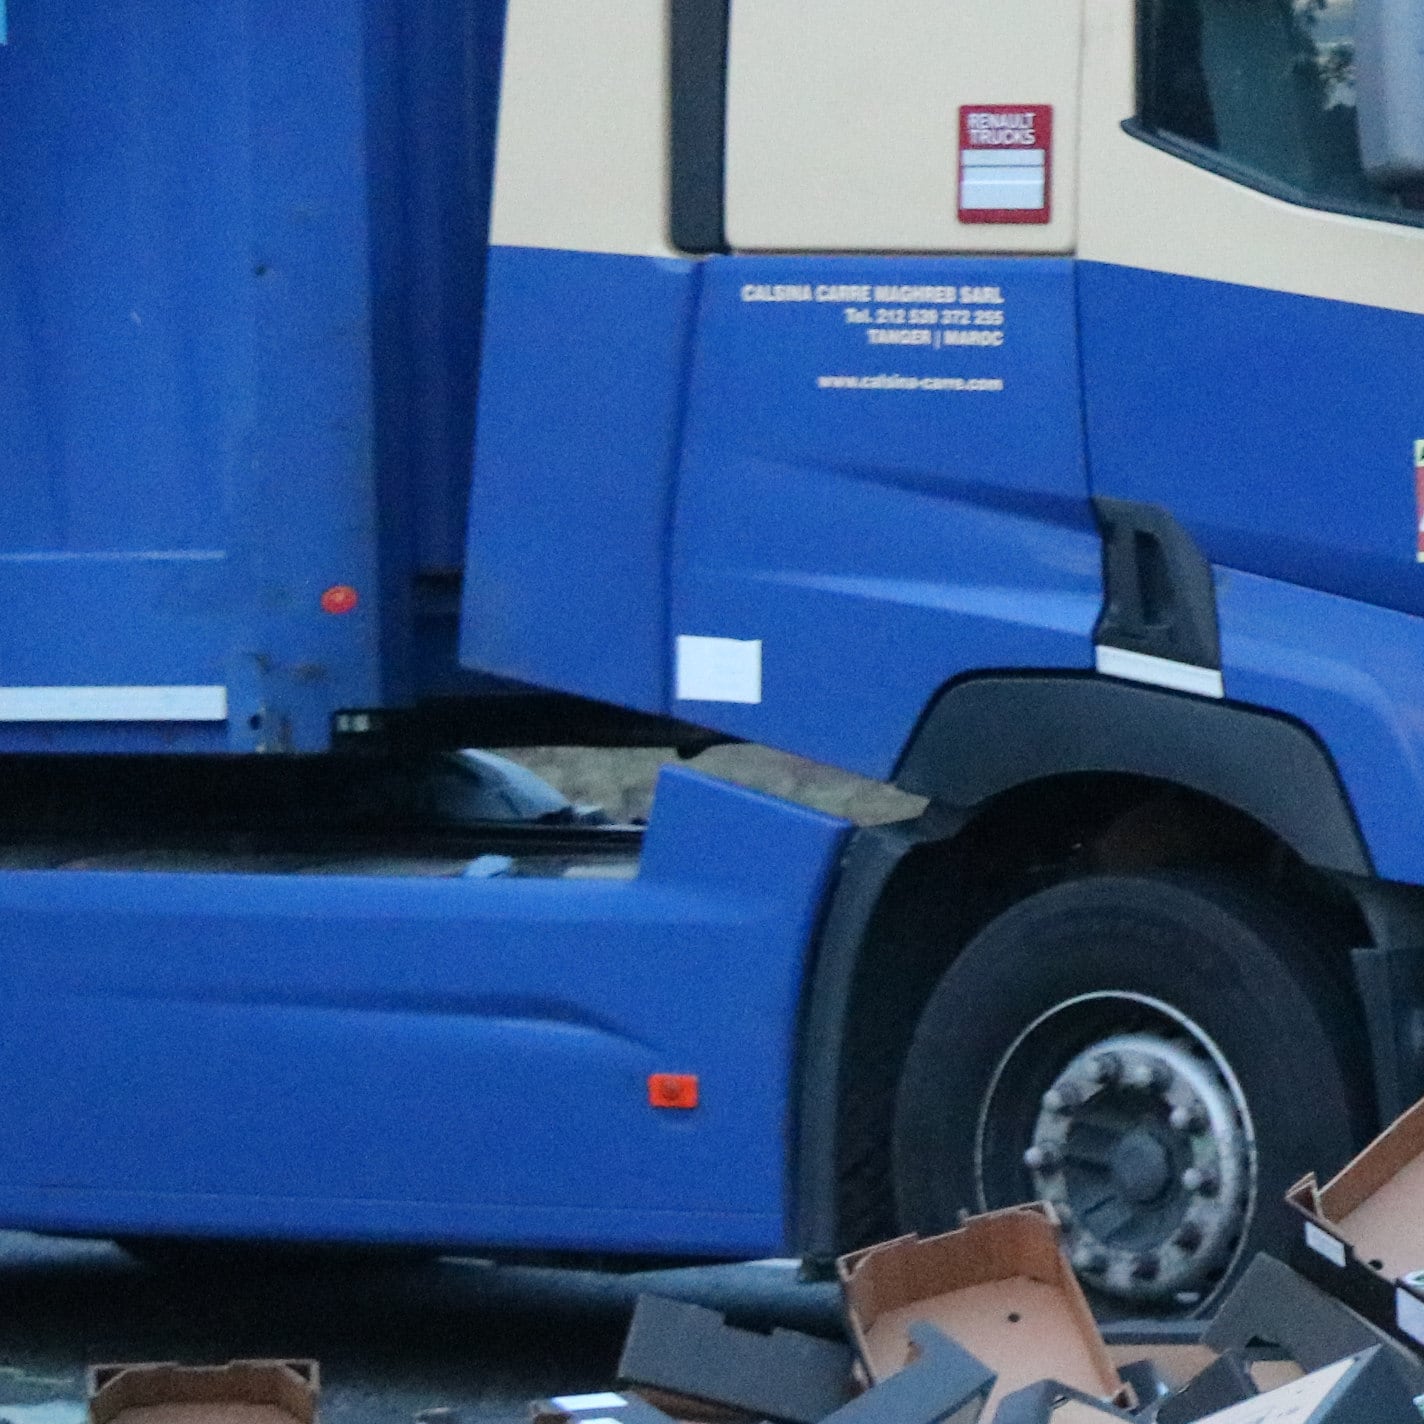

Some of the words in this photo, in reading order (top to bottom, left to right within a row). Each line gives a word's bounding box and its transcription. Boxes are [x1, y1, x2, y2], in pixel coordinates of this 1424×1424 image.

[968, 112, 1036, 129] RENAULT
[969, 129, 1036, 145] TRUCKS
[815, 285, 871, 302] CARRE
[844, 308, 873, 324] Tel.
